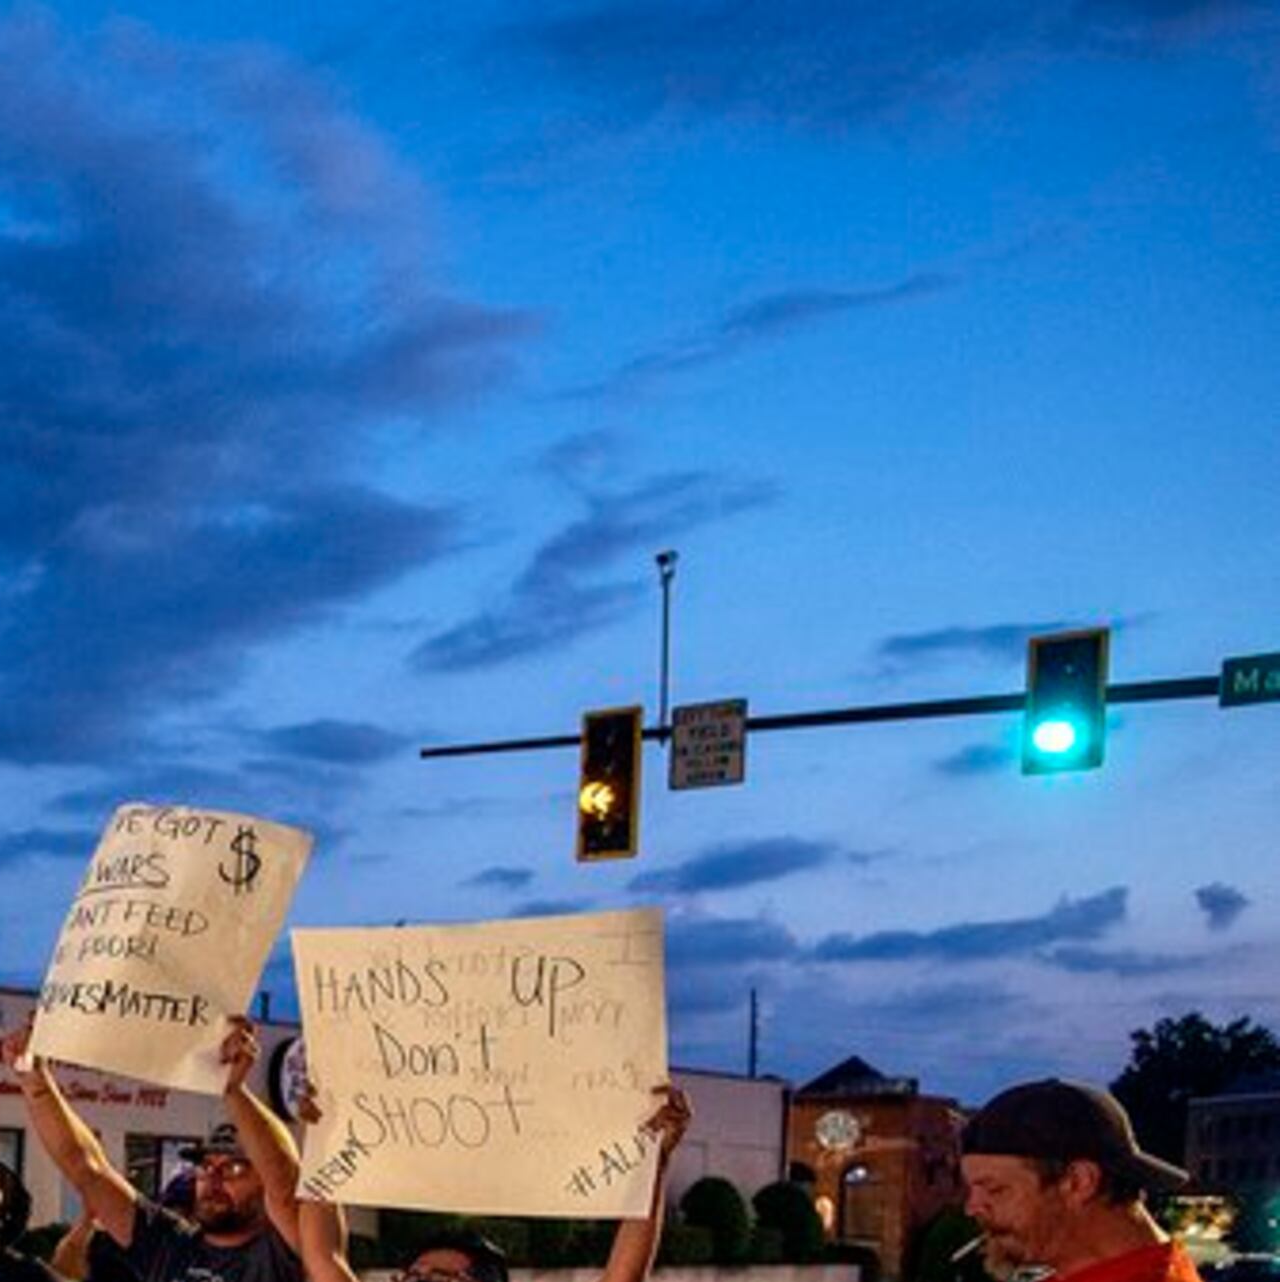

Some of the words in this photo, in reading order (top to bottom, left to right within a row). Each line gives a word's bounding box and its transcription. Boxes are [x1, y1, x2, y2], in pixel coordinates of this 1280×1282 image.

[154, 807, 226, 845] GOT
[96, 853, 171, 889] WARS
[123, 899, 209, 937] FEED
[314, 956, 450, 1013] HANDS
[509, 954, 587, 1038] UP
